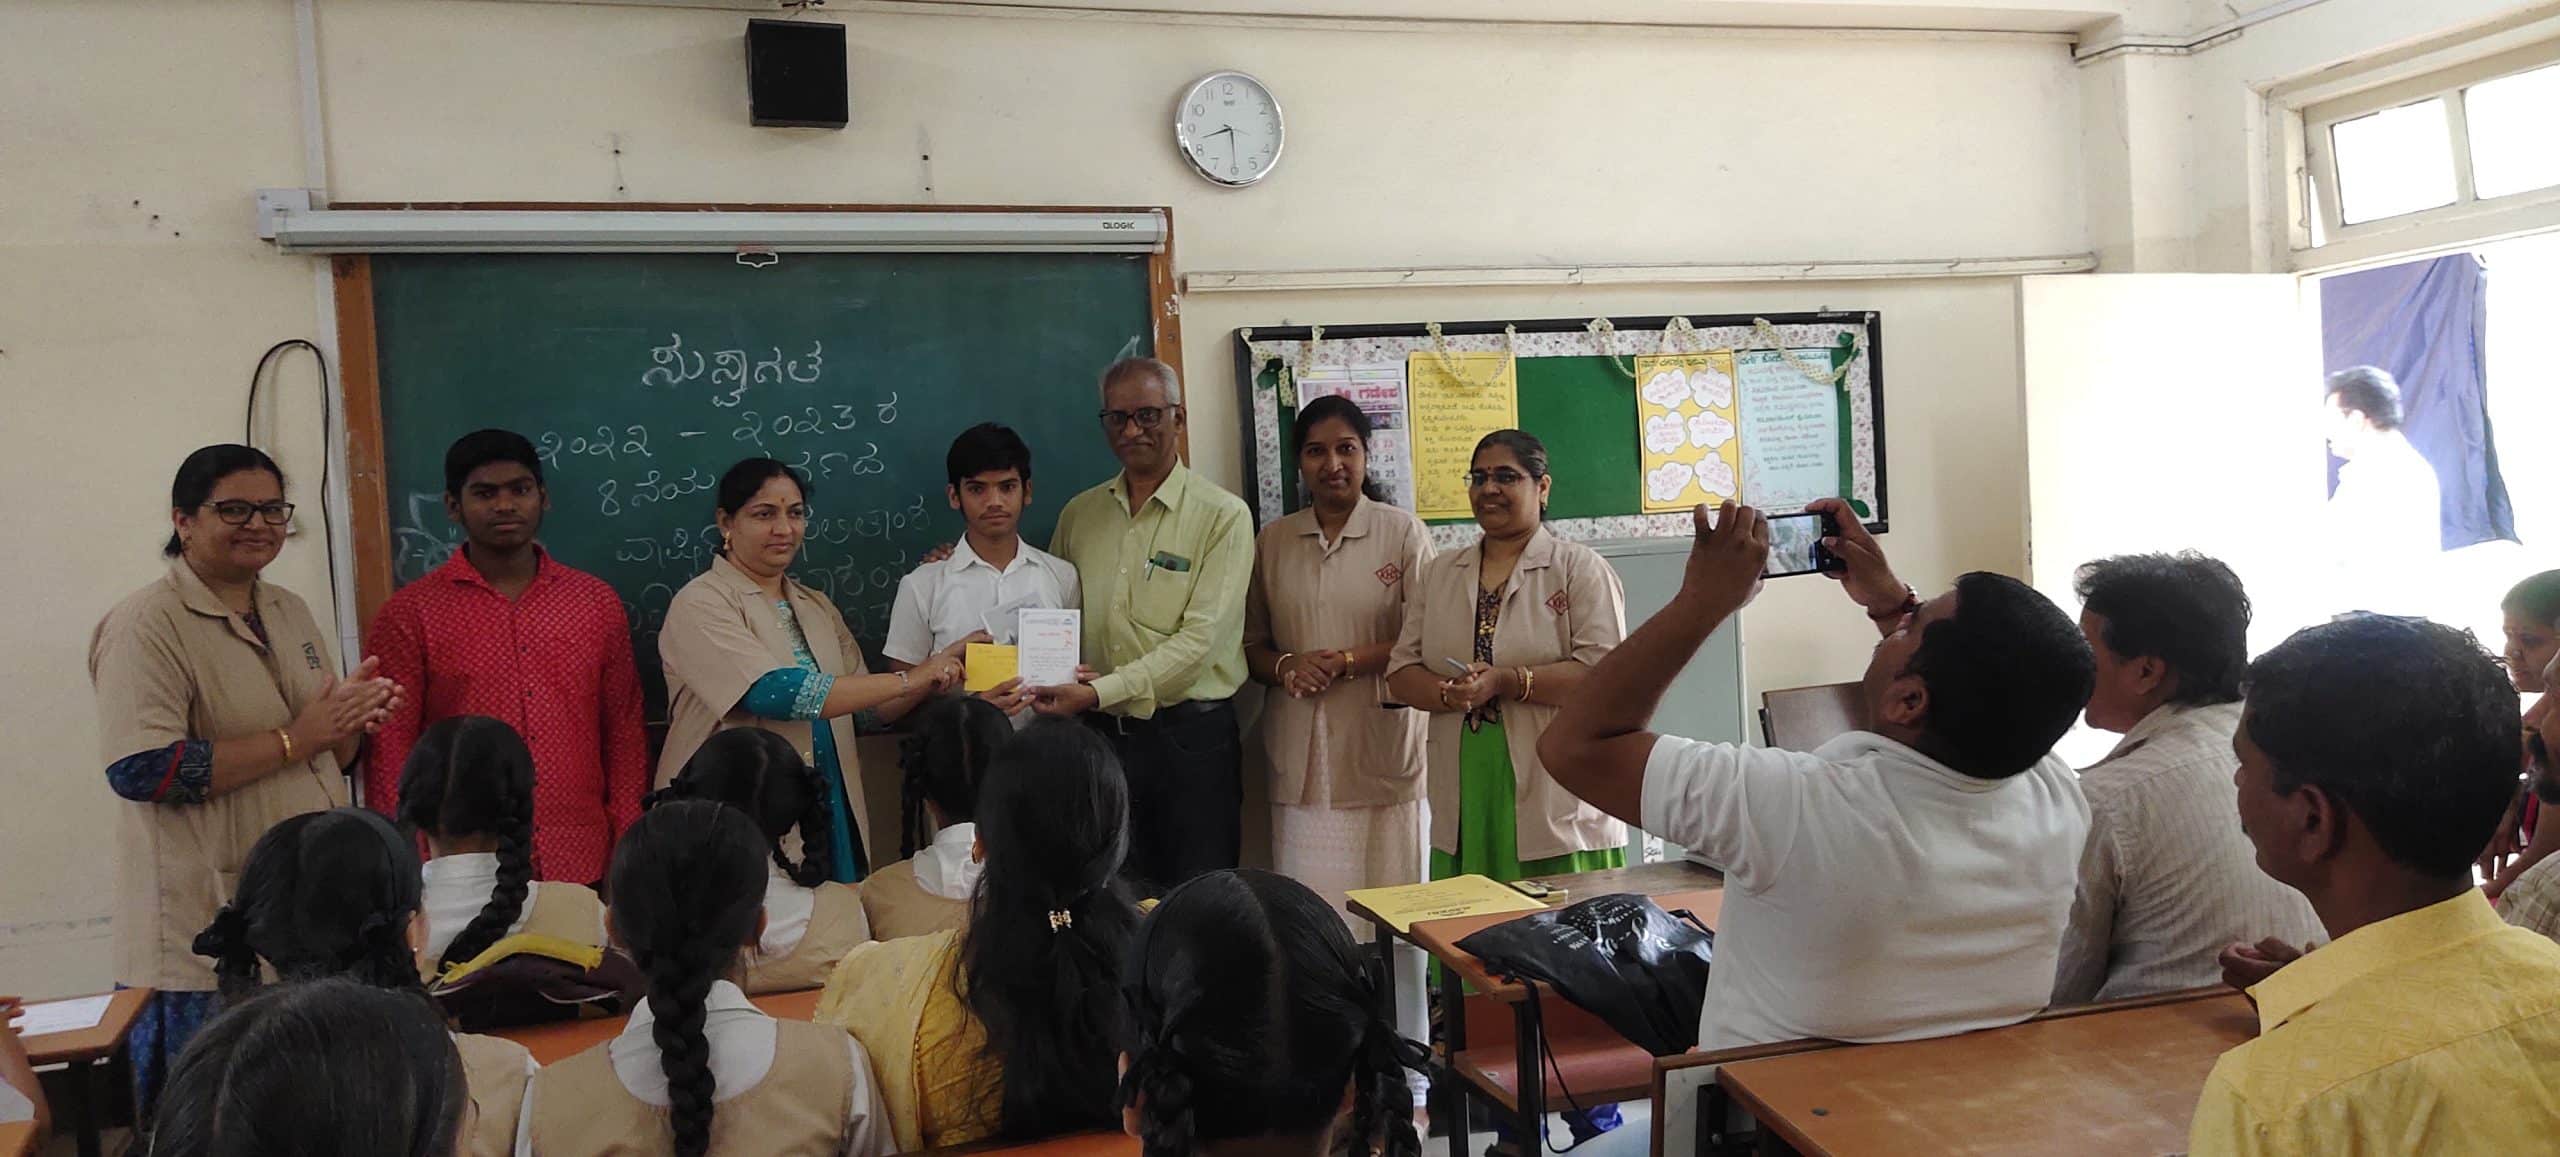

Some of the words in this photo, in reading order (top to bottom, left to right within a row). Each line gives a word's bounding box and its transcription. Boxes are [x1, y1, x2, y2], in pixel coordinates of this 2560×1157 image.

[1222, 82, 1233, 95] 12
[1187, 123, 1196, 135] 9
[1266, 122, 1274, 135] 3
[1196, 144, 1205, 156] 8
[1209, 156, 1219, 170] 7
[1248, 156, 1257, 170] 5
[642, 333, 822, 407] ಸುಸ್ವಾಗತ
